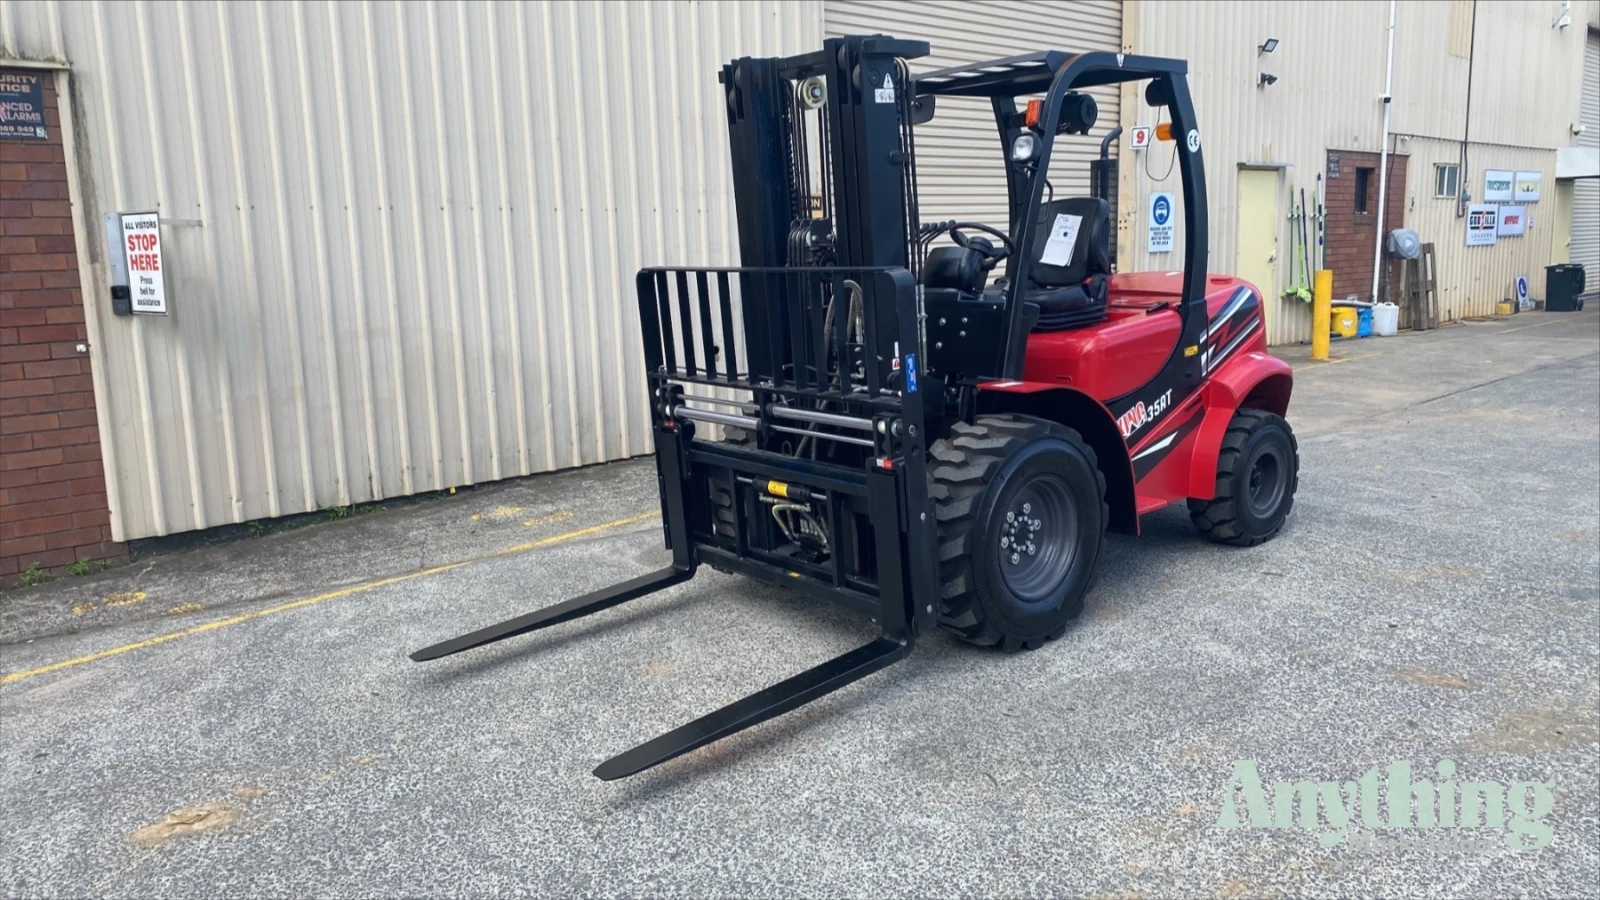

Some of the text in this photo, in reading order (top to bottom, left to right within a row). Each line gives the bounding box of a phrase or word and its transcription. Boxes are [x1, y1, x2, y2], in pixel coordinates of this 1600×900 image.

[1136, 130, 1145, 144] 9
[125, 220, 157, 230] ALL VISITORS
[128, 234, 157, 252] STOP
[129, 254, 160, 271] HERE
[140, 276, 153, 284] Press
[140, 287, 148, 295] bell
[137, 299, 161, 307] assistance
